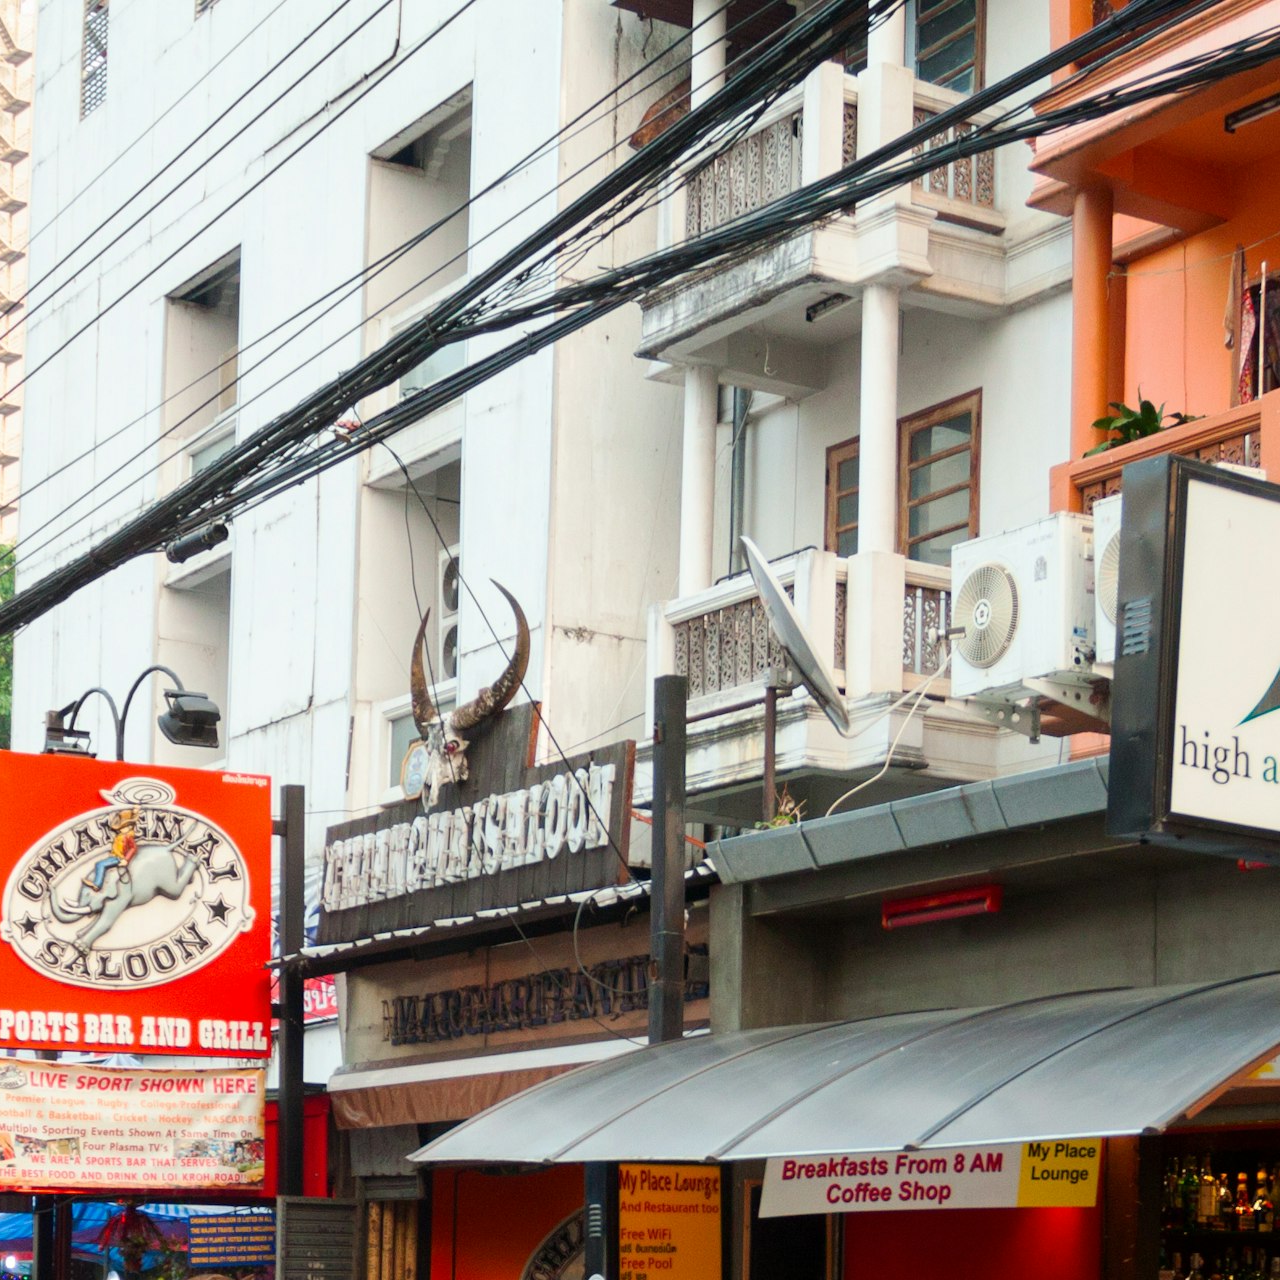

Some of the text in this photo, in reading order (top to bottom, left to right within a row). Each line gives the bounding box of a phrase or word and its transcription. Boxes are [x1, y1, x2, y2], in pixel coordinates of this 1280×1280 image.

[1179, 725, 1251, 784] high
[36, 920, 212, 981] SALOON
[84, 1013, 134, 1046] BAR
[140, 1016, 191, 1048] AND
[199, 1019, 268, 1051] GRILL
[29, 1071, 68, 1089] LIVE
[75, 1075, 133, 1092] SPORT
[139, 1076, 204, 1094] SHOWN
[213, 1077, 257, 1095] HERE
[5, 1093, 46, 1104] Premier
[50, 1096, 85, 1107] League
[97, 1098, 129, 1110] Rugby
[36, 1111, 43, 1119] &
[48, 1110, 102, 1121] Basketball
[112, 1112, 148, 1123] Cricket
[158, 1114, 193, 1125] Hockey
[42, 1125, 86, 1137] Sporting
[91, 1127, 124, 1137] Events
[128, 1128, 161, 1138] Shown
[166, 1129, 177, 1138] At
[180, 1130, 209, 1139] Same
[213, 1129, 236, 1139] Time
[240, 1130, 253, 1139] On
[83, 1141, 105, 1151] Four
[110, 1142, 144, 1152] Plasma
[1028, 1143, 1096, 1160] My Place
[51, 1156, 70, 1165] ARE
[86, 1157, 122, 1166] SPORTS
[126, 1158, 146, 1166] BAR
[152, 1158, 176, 1166] THAT
[180, 1158, 219, 1167] SERVES
[782, 1153, 1003, 1180] Breakfasts From 8 AM
[0, 1168, 17, 1177] THE
[22, 1169, 44, 1178] BEST
[48, 1170, 76, 1179] FOOD
[81, 1171, 102, 1180] AND
[107, 1172, 138, 1181] DRINK
[142, 1173, 157, 1181] ON
[162, 1173, 177, 1182] LOI
[182, 1173, 210, 1182] KROH
[1031, 1166, 1088, 1184] Lounge
[620, 1170, 718, 1199] My Place Lounge
[827, 1181, 951, 1204] Coffee Shop
[621, 1202, 718, 1213] And Restaurant too
[621, 1228, 671, 1239] Free WiFi
[621, 1258, 672, 1269] Free Pool
